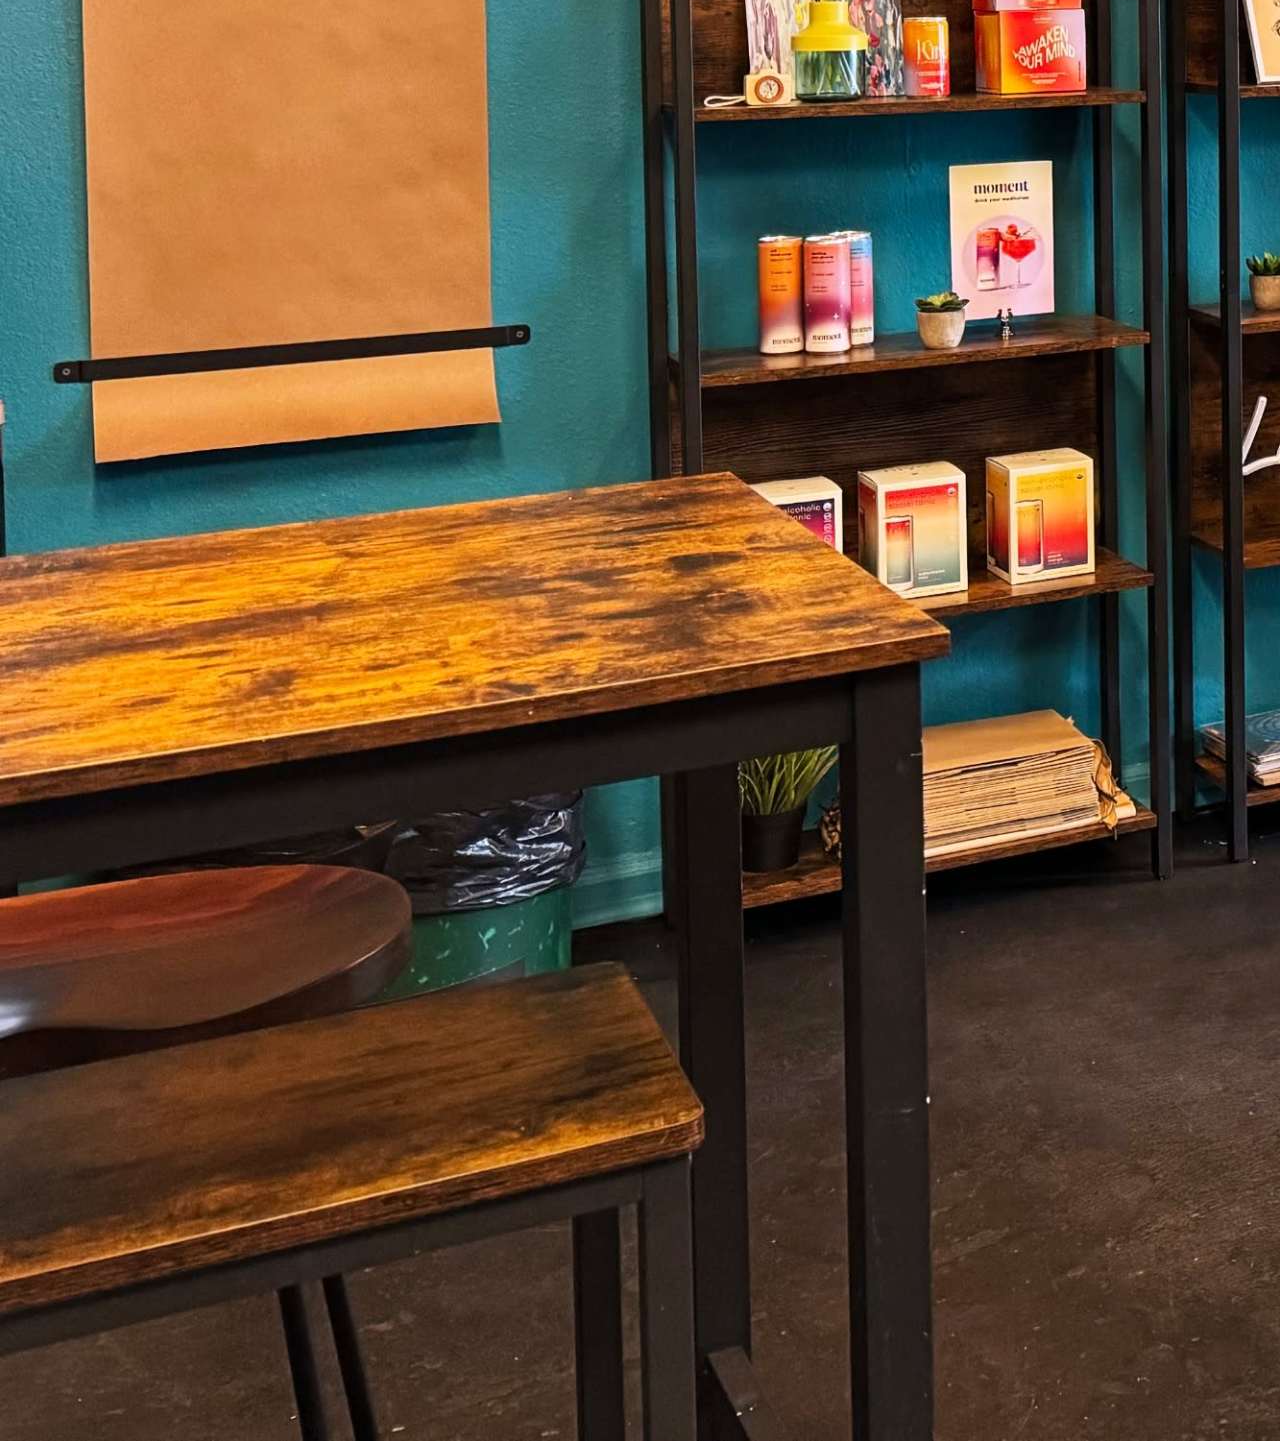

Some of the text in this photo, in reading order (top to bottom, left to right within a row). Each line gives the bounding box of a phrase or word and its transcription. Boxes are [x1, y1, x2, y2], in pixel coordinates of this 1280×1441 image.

[1018, 25, 1069, 57] AWAKEN
[1045, 40, 1076, 63] MIND
[973, 180, 1029, 195] moment
